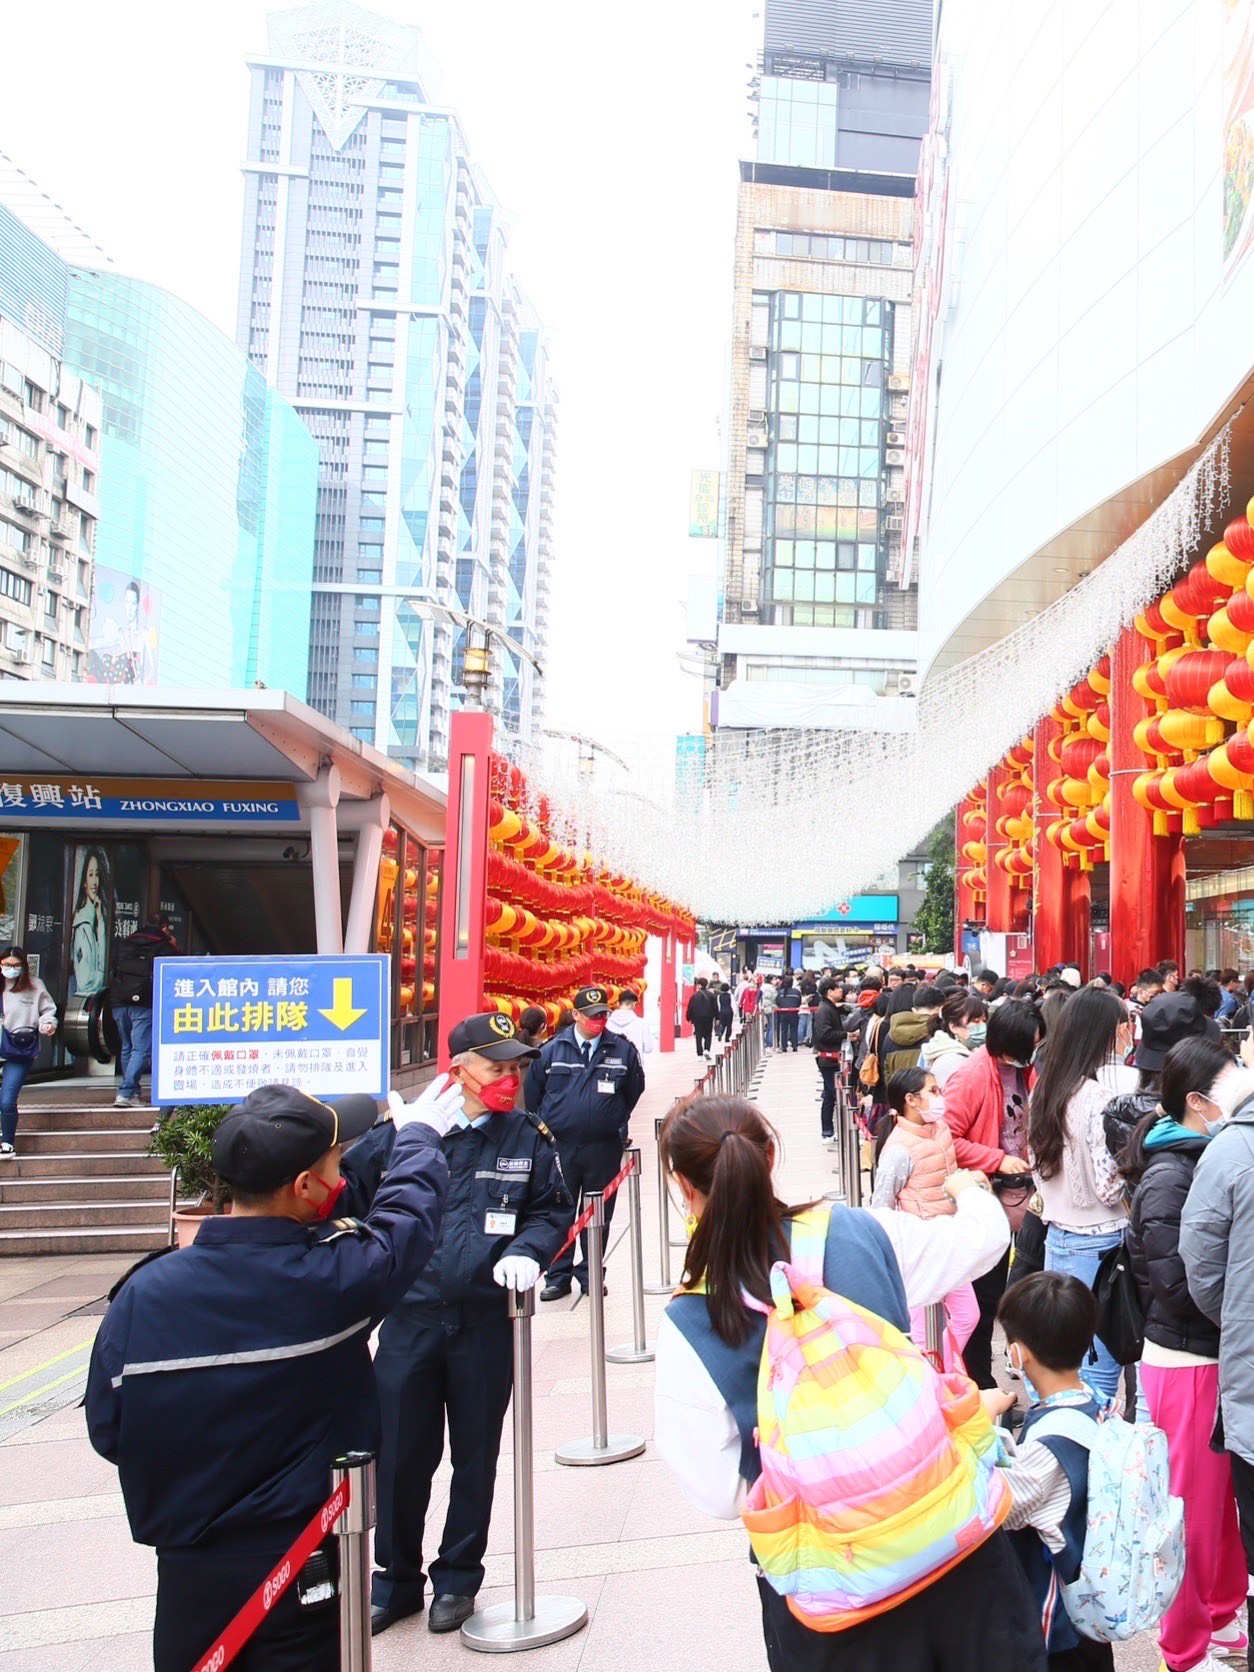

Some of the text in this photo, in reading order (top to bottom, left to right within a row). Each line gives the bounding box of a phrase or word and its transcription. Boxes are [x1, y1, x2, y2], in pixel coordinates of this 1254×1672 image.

[0, 783, 103, 810] 復興站
[120, 800, 279, 813] ZHONGXIAO FUXING
[173, 976, 310, 998] 進入館內 請您
[173, 1001, 309, 1034] 由此排隊
[328, 1491, 343, 1521] SOGO
[271, 1560, 291, 1596] SOGO
